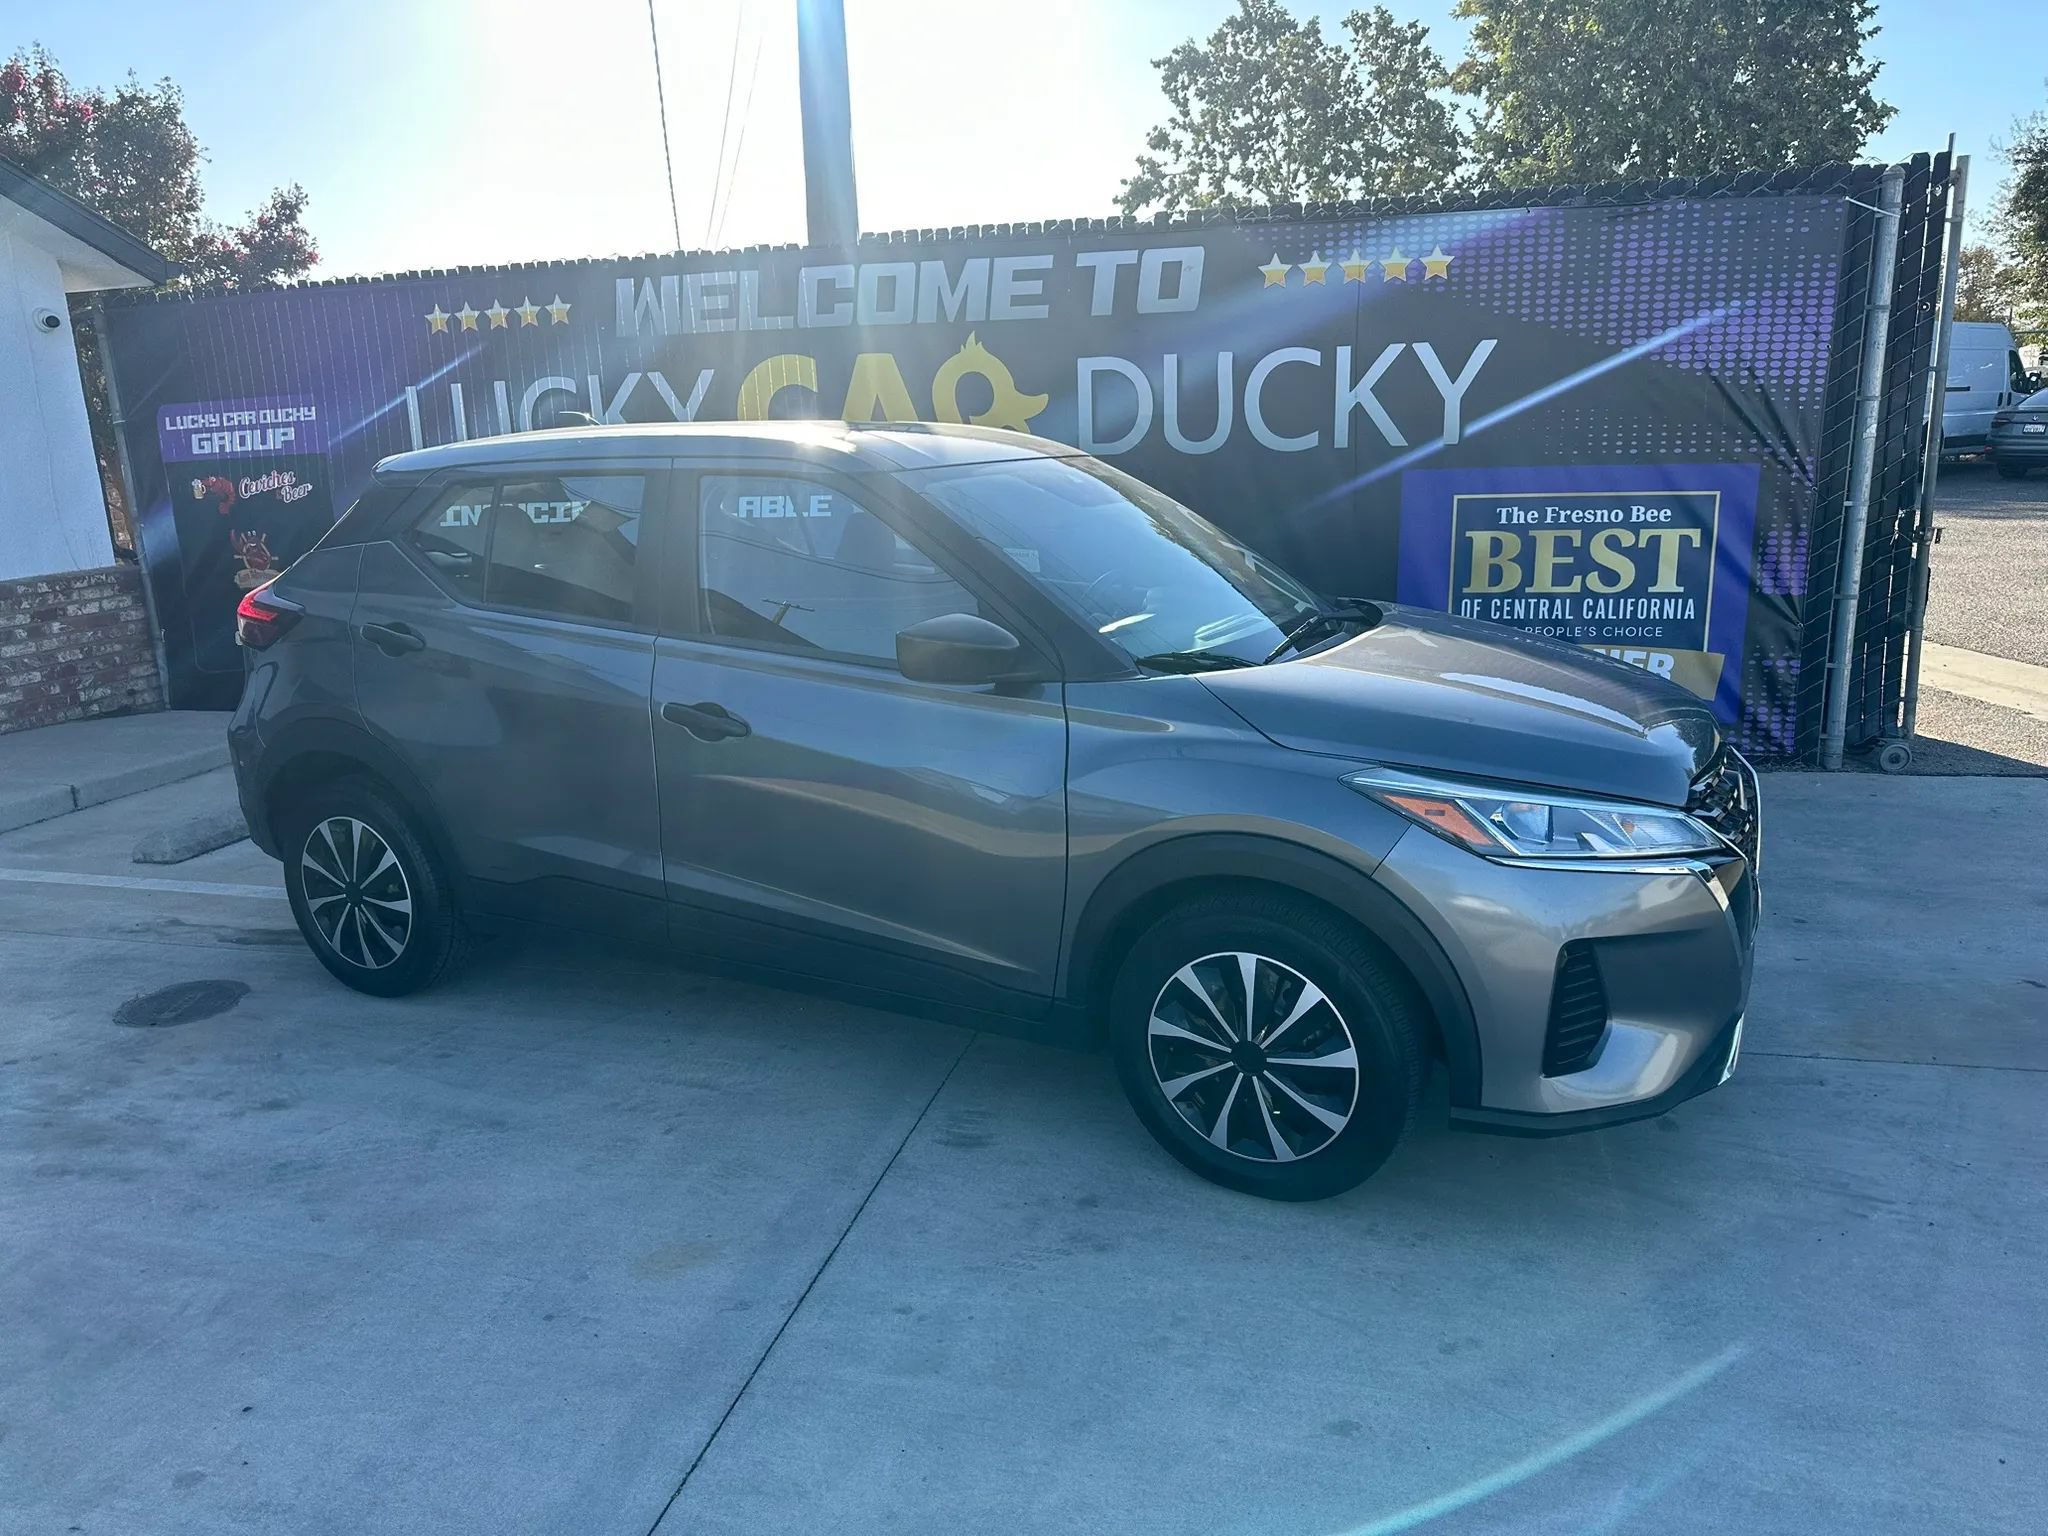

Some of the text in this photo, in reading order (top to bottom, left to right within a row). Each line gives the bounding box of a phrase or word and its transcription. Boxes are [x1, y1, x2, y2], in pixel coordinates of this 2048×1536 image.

[615, 246, 1205, 338] WELCOME TO
[1076, 338, 1498, 456] DUCKY
[165, 412, 220, 431] LUCKY
[222, 410, 257, 427] CAR
[191, 427, 295, 455] GROUP
[239, 470, 296, 499] Ceviches
[280, 482, 313, 504] Beer
[1497, 504, 1673, 525] The Fresno Bee
[1461, 527, 1702, 594] BEST
[1461, 598, 1697, 620] OF CENTRAL CALIFORNIA
[1602, 625, 1664, 638] CHOICE
